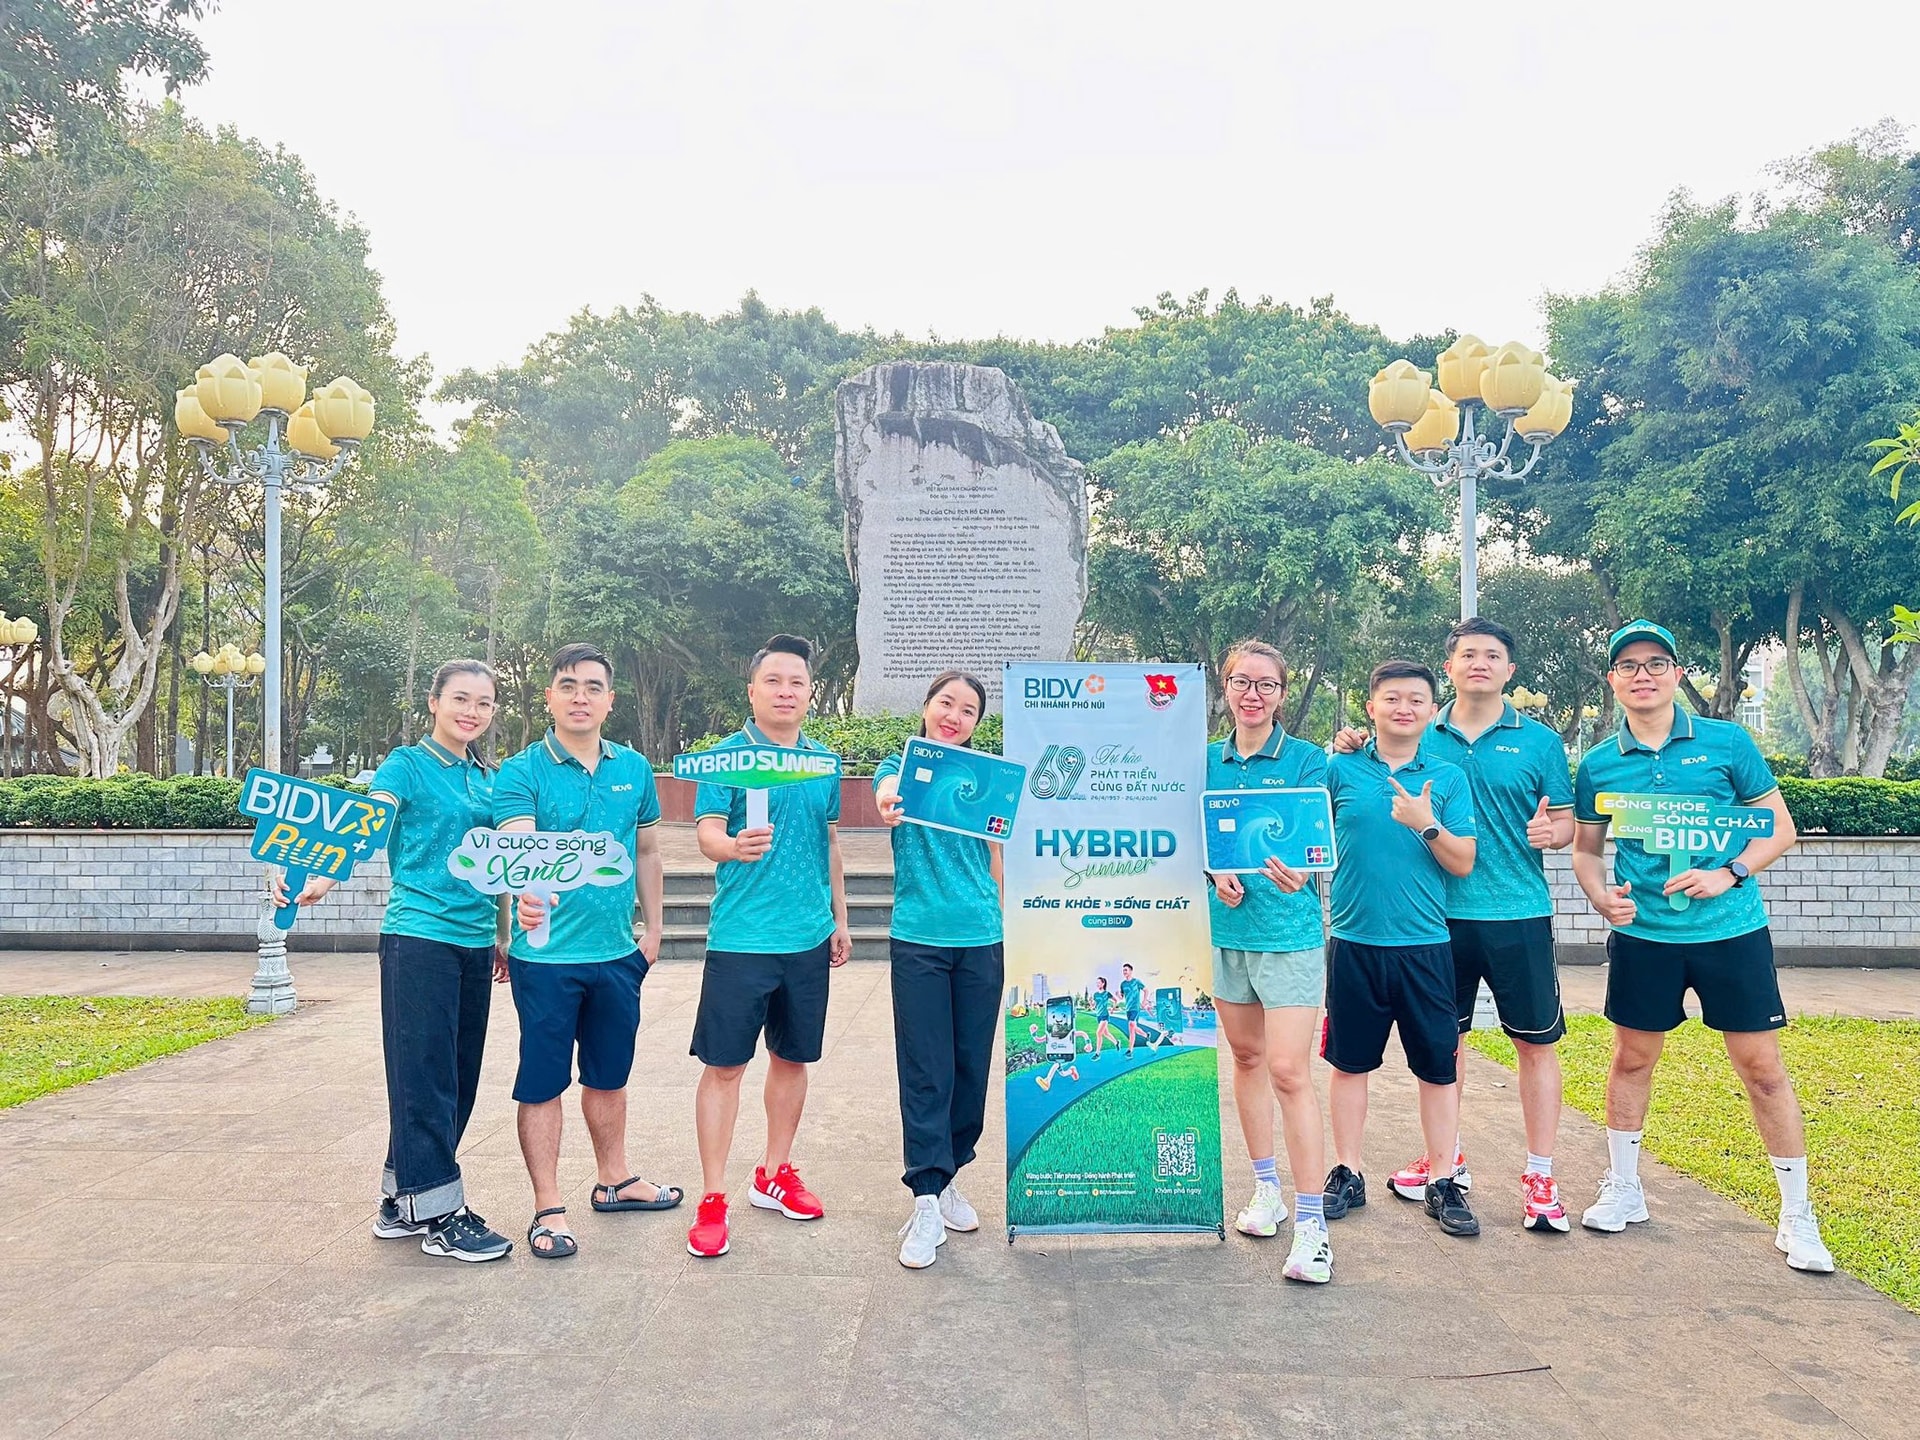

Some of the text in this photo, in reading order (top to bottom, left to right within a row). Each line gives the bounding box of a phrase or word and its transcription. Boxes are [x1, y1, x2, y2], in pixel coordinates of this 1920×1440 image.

[1024, 677, 1085, 699] BIDV
[1024, 698, 1105, 710] CHI NHÁNH PHỐ NÚI
[678, 750, 756, 775] HYBRID
[912, 746, 936, 759] BIDV
[1029, 744, 1086, 800] 69
[1091, 766, 1157, 780] PHÁT TRIỂN
[1090, 781, 1186, 792] CÙNG ĐẤT NƯỚC
[246, 775, 356, 832] BIDV
[1208, 799, 1232, 809] BIDV
[1603, 795, 1652, 810] SỐNG
[1652, 810, 1709, 826] SỐNG
[257, 822, 347, 874] Run
[471, 833, 607, 856] Vì cuộc sống
[1035, 829, 1177, 858] HYBRID
[1618, 824, 1732, 852] CÙNG BIDV
[486, 852, 583, 890] Xanh
[1060, 845, 1157, 889] Summer
[1023, 896, 1191, 910] SỐNG KHỎE SỐNG CHẤT
[1087, 916, 1127, 927] cùng BIDV
